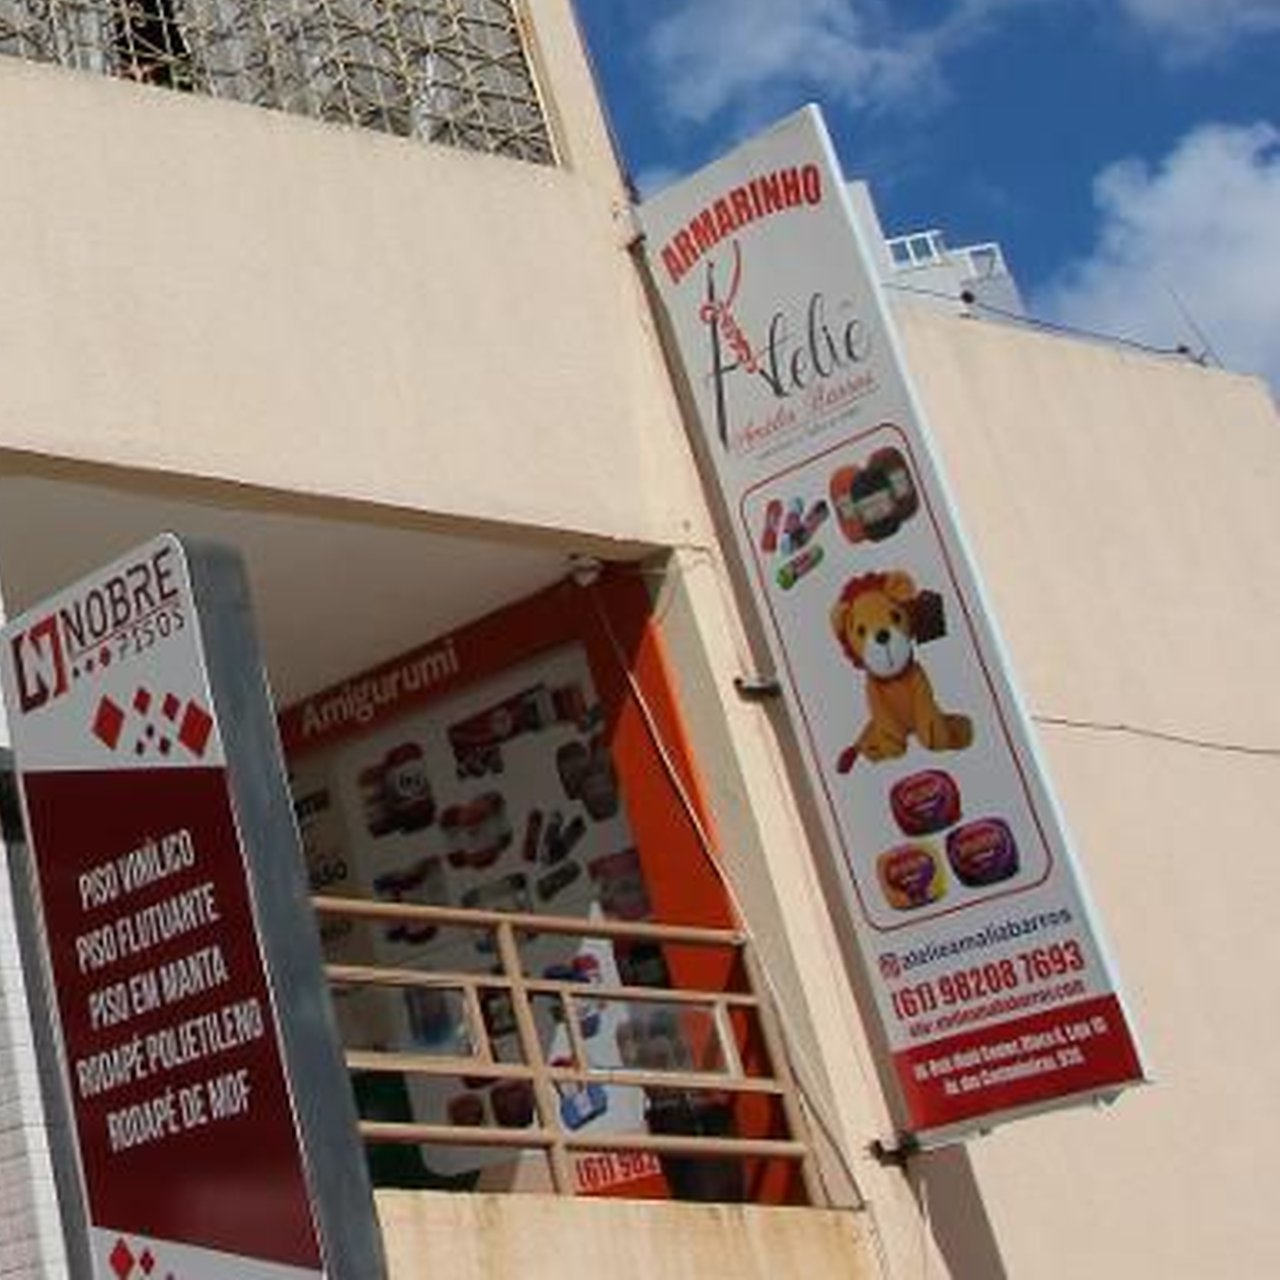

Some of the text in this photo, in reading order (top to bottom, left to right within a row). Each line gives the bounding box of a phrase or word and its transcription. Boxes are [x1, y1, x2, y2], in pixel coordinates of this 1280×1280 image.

[660, 163, 822, 284] ARMARINHO
[59, 546, 178, 653] NOBRE
[301, 638, 459, 737] Amigurumi
[78, 828, 195, 911] PISO VINÍLICO
[75, 881, 221, 975] PISO FLUTUANTE
[88, 945, 229, 1031] PISO EM MANTA
[891, 939, 1085, 1019] (61) 98208 7693
[76, 997, 265, 1099] RODAPÉ POLIETILENO
[106, 1069, 252, 1153] RODAPÉ DE MDF
[576, 1152, 616, 1189] (61)
